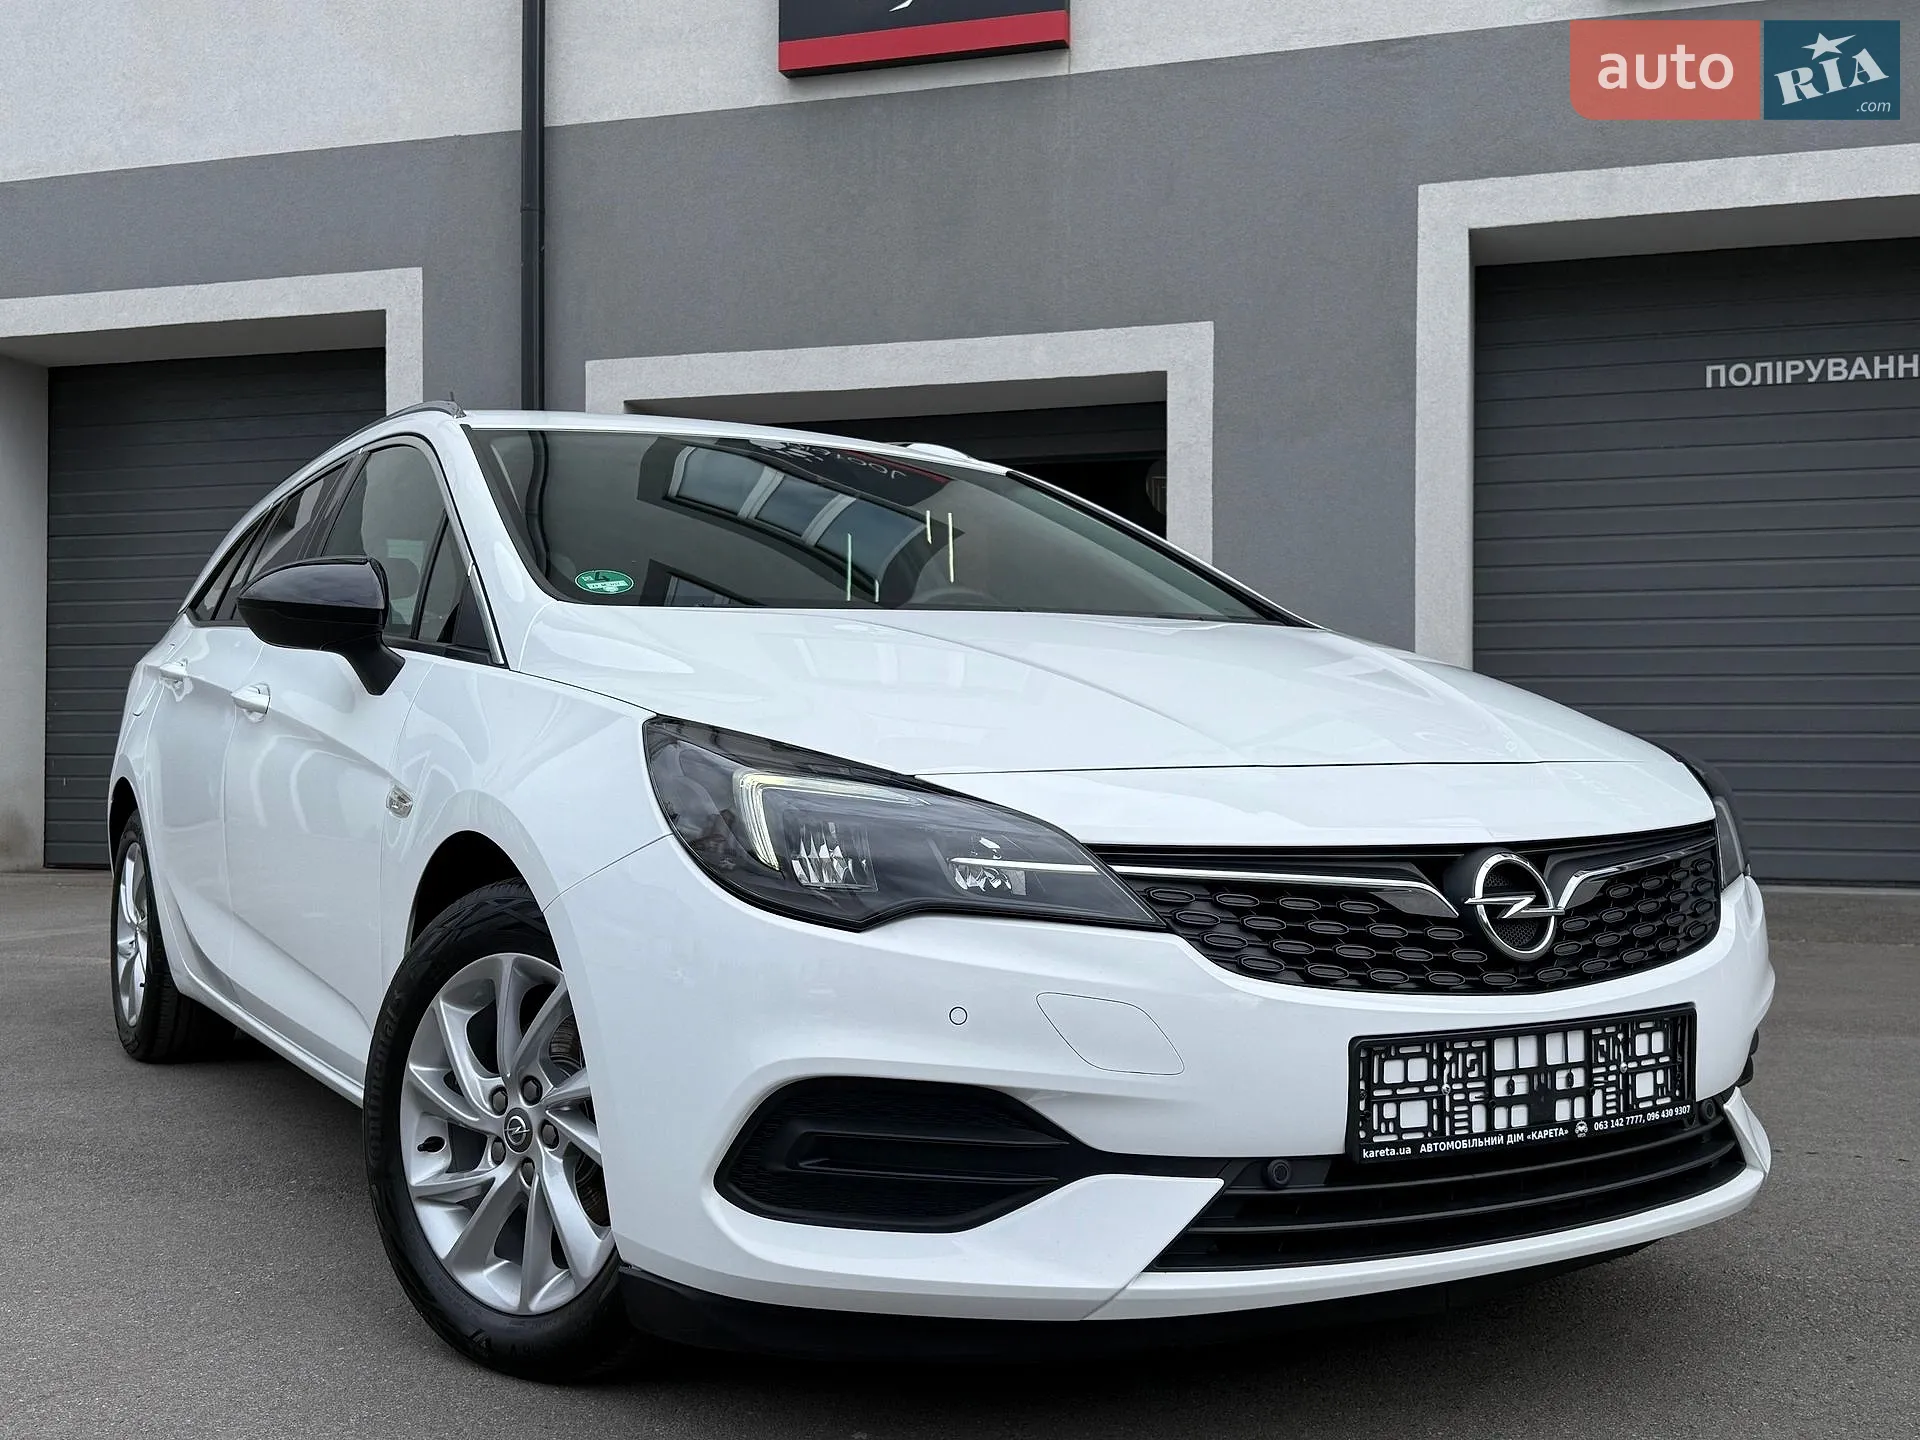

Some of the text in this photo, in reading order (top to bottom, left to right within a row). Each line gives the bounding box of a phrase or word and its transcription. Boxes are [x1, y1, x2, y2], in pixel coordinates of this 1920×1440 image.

[1705, 354, 1920, 388] ПОЛІРУВАНН
[1362, 1146, 1412, 1159] kareta.ua
[1419, 1134, 1504, 1153] АВТОМОБІЛЬНИЙ
[1506, 1132, 1525, 1145] ДІМ
[1526, 1127, 1569, 1140] «КАРЕТА»
[1594, 1120, 1608, 1131] 063
[1611, 1117, 1624, 1128] 142
[1625, 1114, 1646, 1126] 7777,
[1674, 1104, 1691, 1115] 9307
